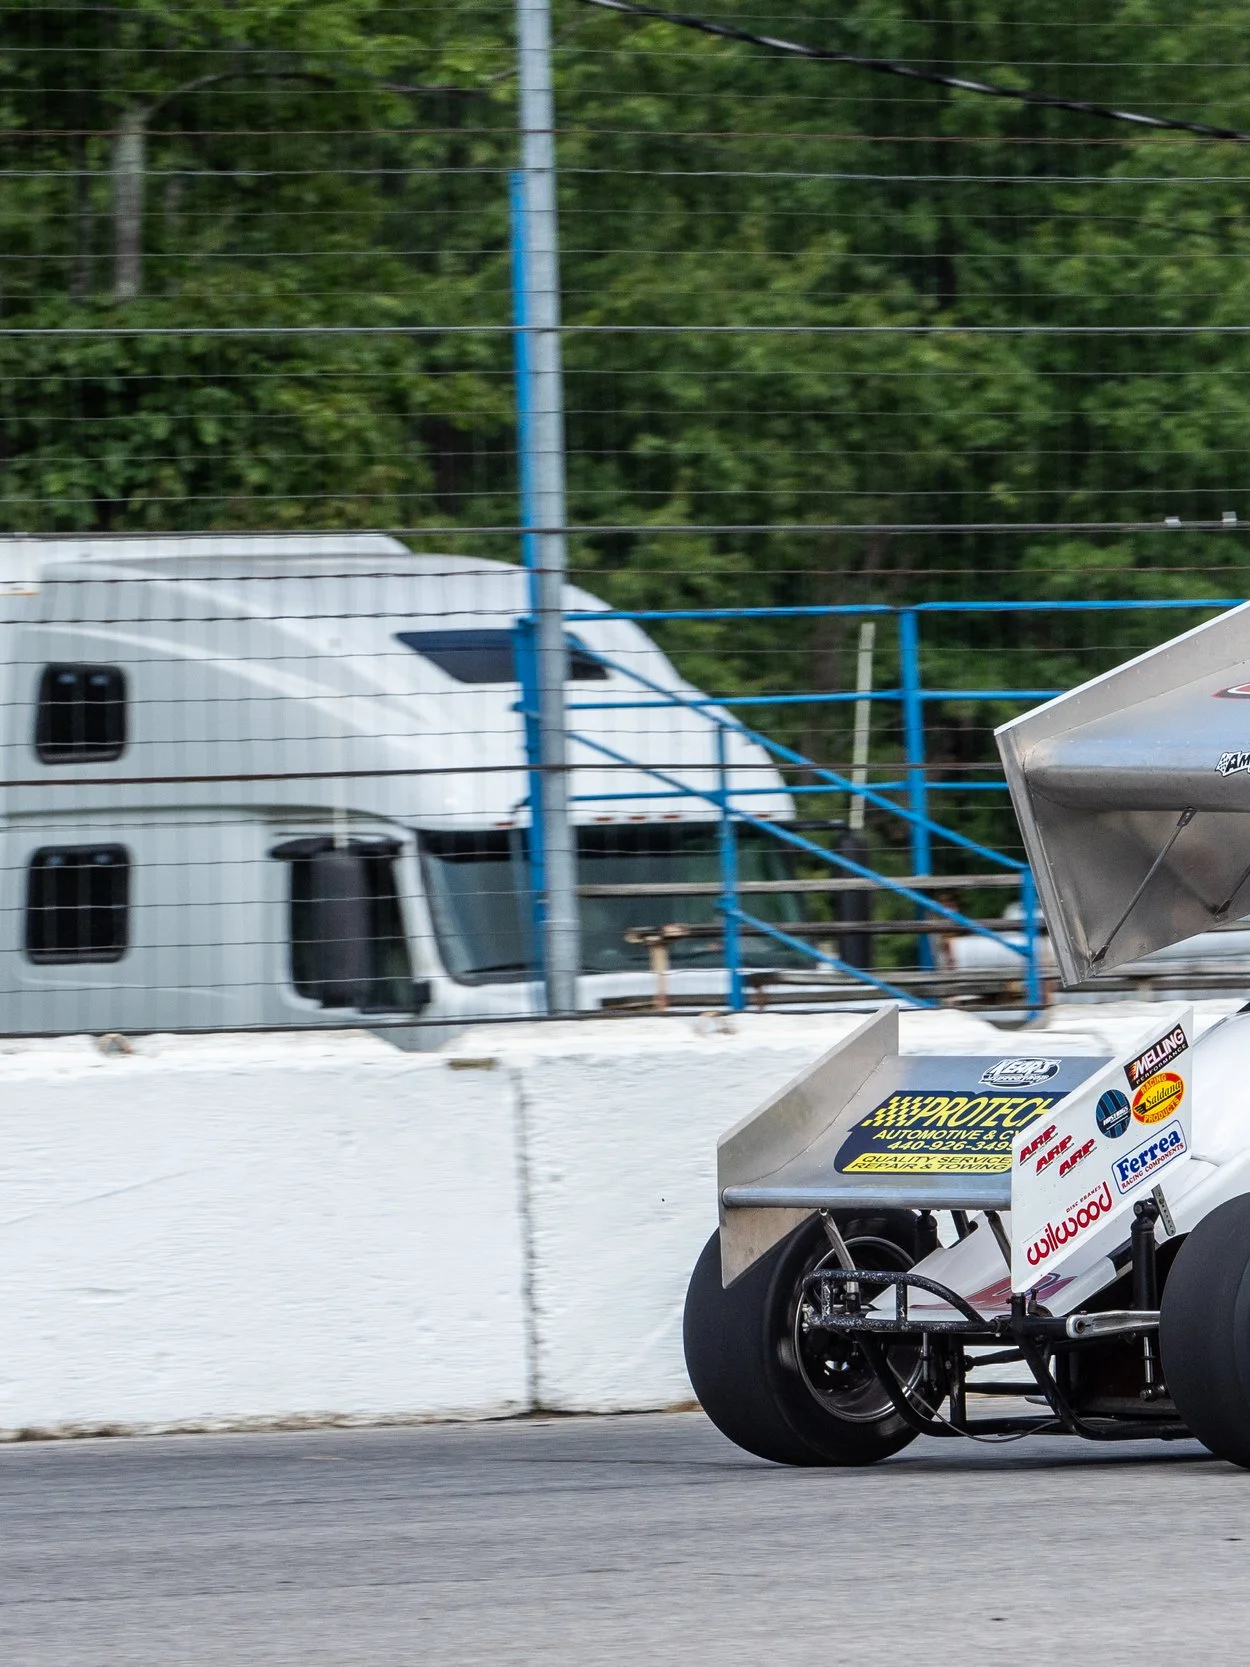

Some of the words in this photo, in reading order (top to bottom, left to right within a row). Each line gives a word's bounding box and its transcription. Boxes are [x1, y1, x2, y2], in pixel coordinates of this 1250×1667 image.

[1135, 1028, 1184, 1079] MELLING
[1136, 1043, 1187, 1085] PERFORMANCE
[1140, 1073, 1167, 1095] RACING
[1145, 1080, 1182, 1107] Saldana
[1143, 1098, 1180, 1123] PRODUCTS
[872, 1129, 985, 1140] AUTOMOTIVE
[982, 1129, 998, 1140] &
[1020, 1124, 1057, 1163] ARP
[862, 1155, 937, 1164] QUALITY
[1035, 1135, 1073, 1173] ARP
[1059, 1139, 1095, 1177] ARP
[1116, 1130, 1181, 1181] Ferrea
[1121, 1170, 1143, 1189] RACING
[1144, 1142, 1184, 1173] COMPONENTS
[1027, 1181, 1112, 1265] wilwood
